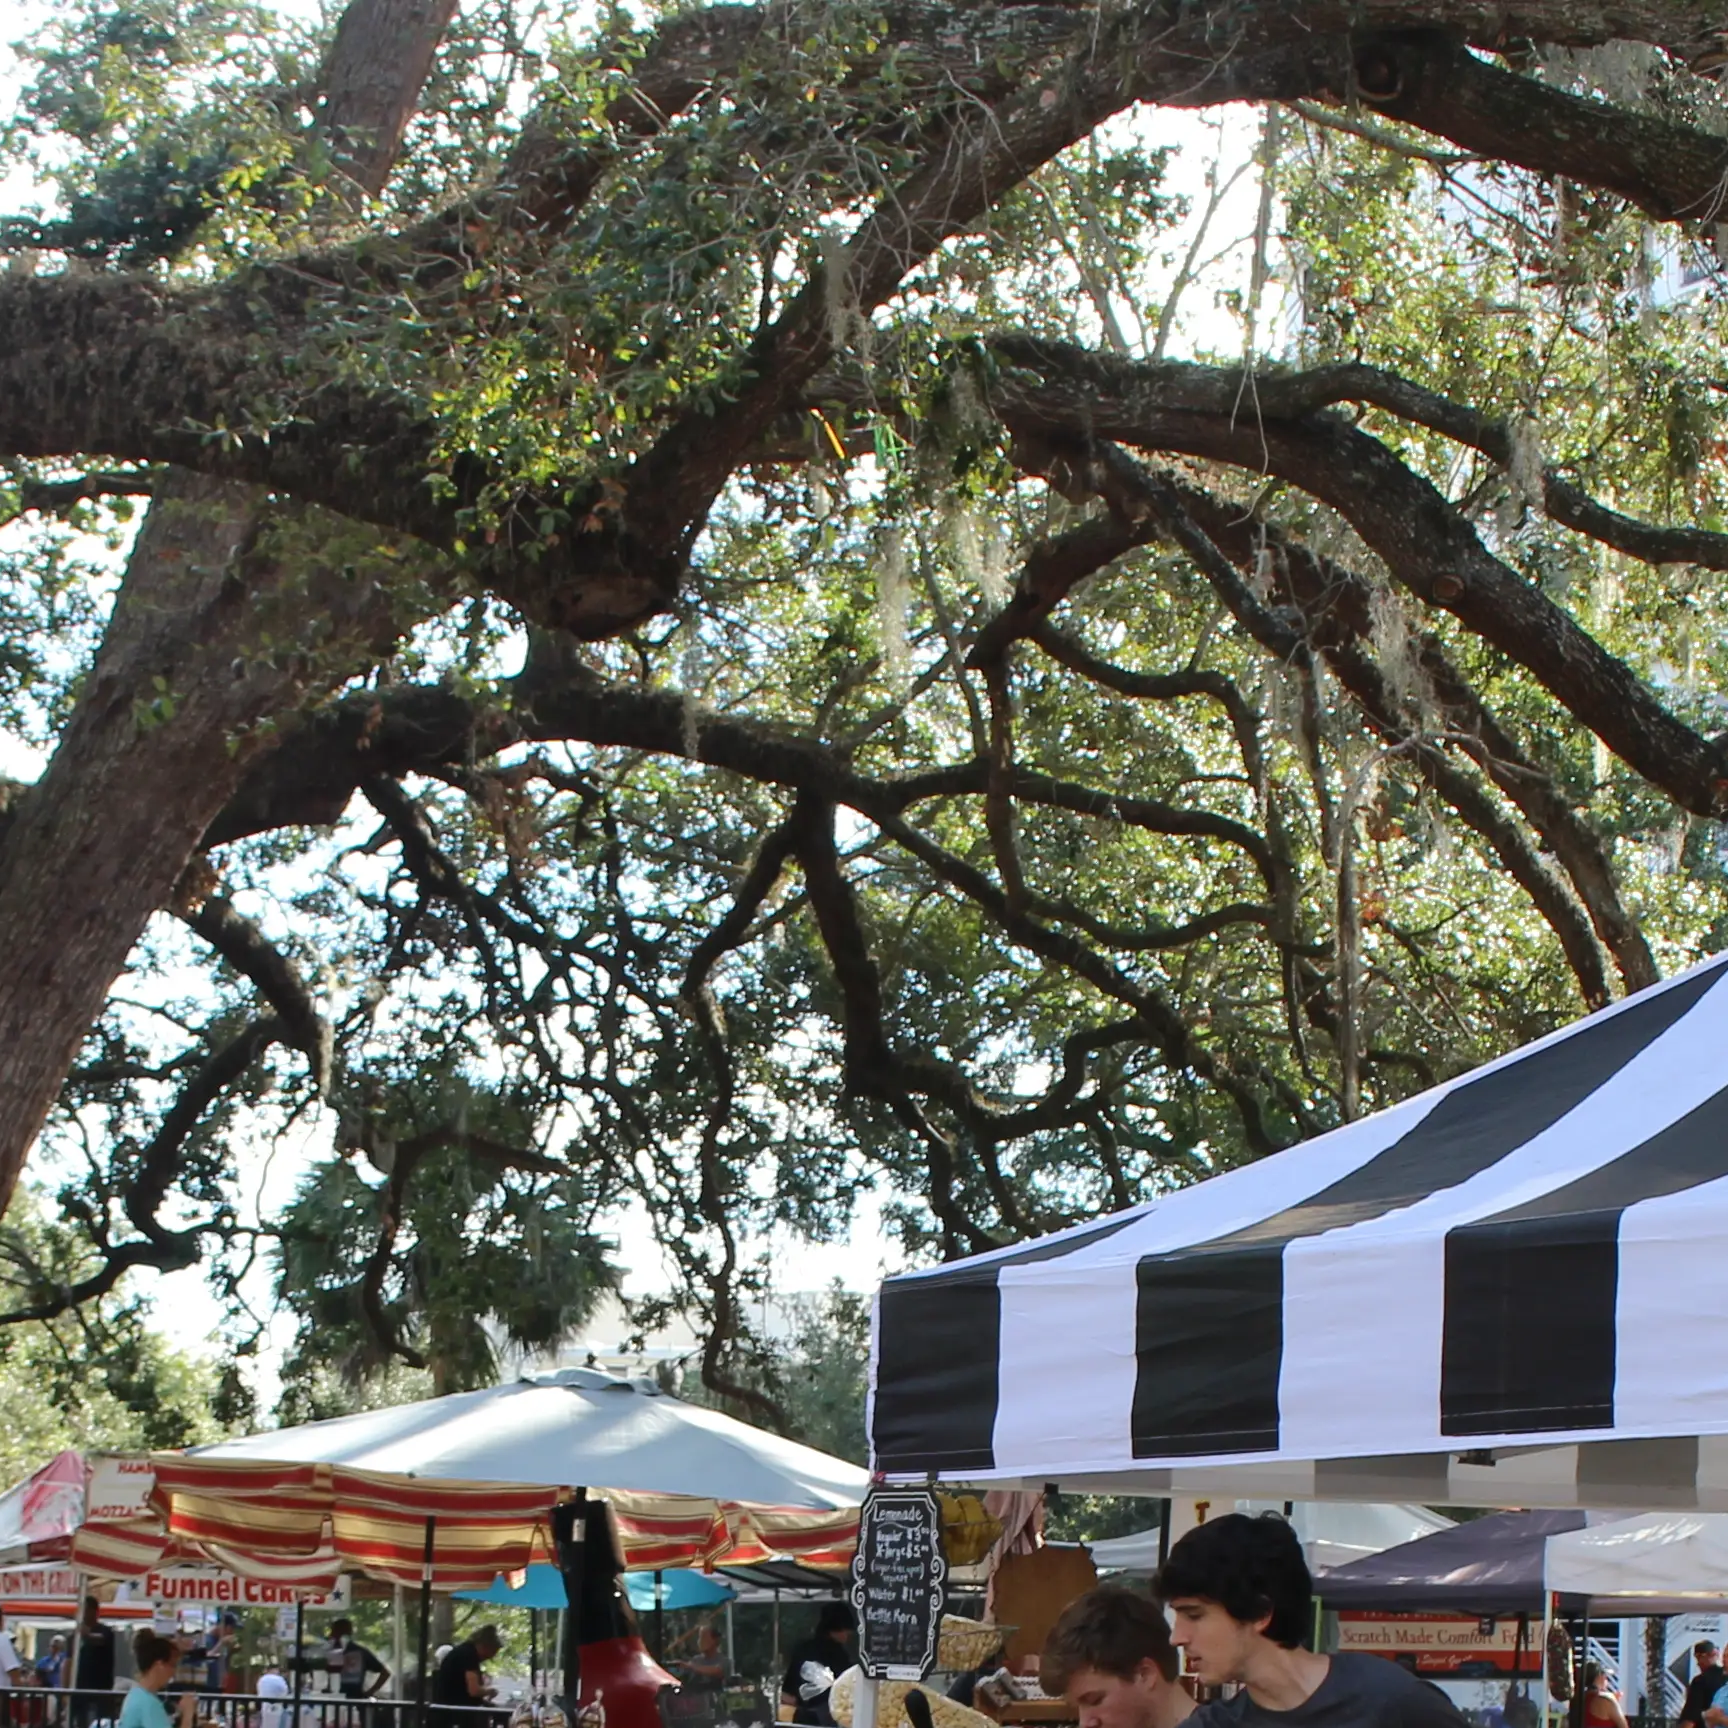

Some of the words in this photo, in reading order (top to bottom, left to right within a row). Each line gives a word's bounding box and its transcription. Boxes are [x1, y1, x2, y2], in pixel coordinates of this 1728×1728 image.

[872, 1503, 924, 1522] Lemonade
[145, 1573, 240, 1601] Funnel
[869, 1587, 897, 1601] Water
[866, 1606, 893, 1624] Kettle
[893, 1607, 918, 1625] Korn
[1343, 1626, 1392, 1644] Scratch
[1395, 1628, 1434, 1645] Made
[1436, 1627, 1493, 1645] Comfort
[1501, 1629, 1535, 1644] Fod
